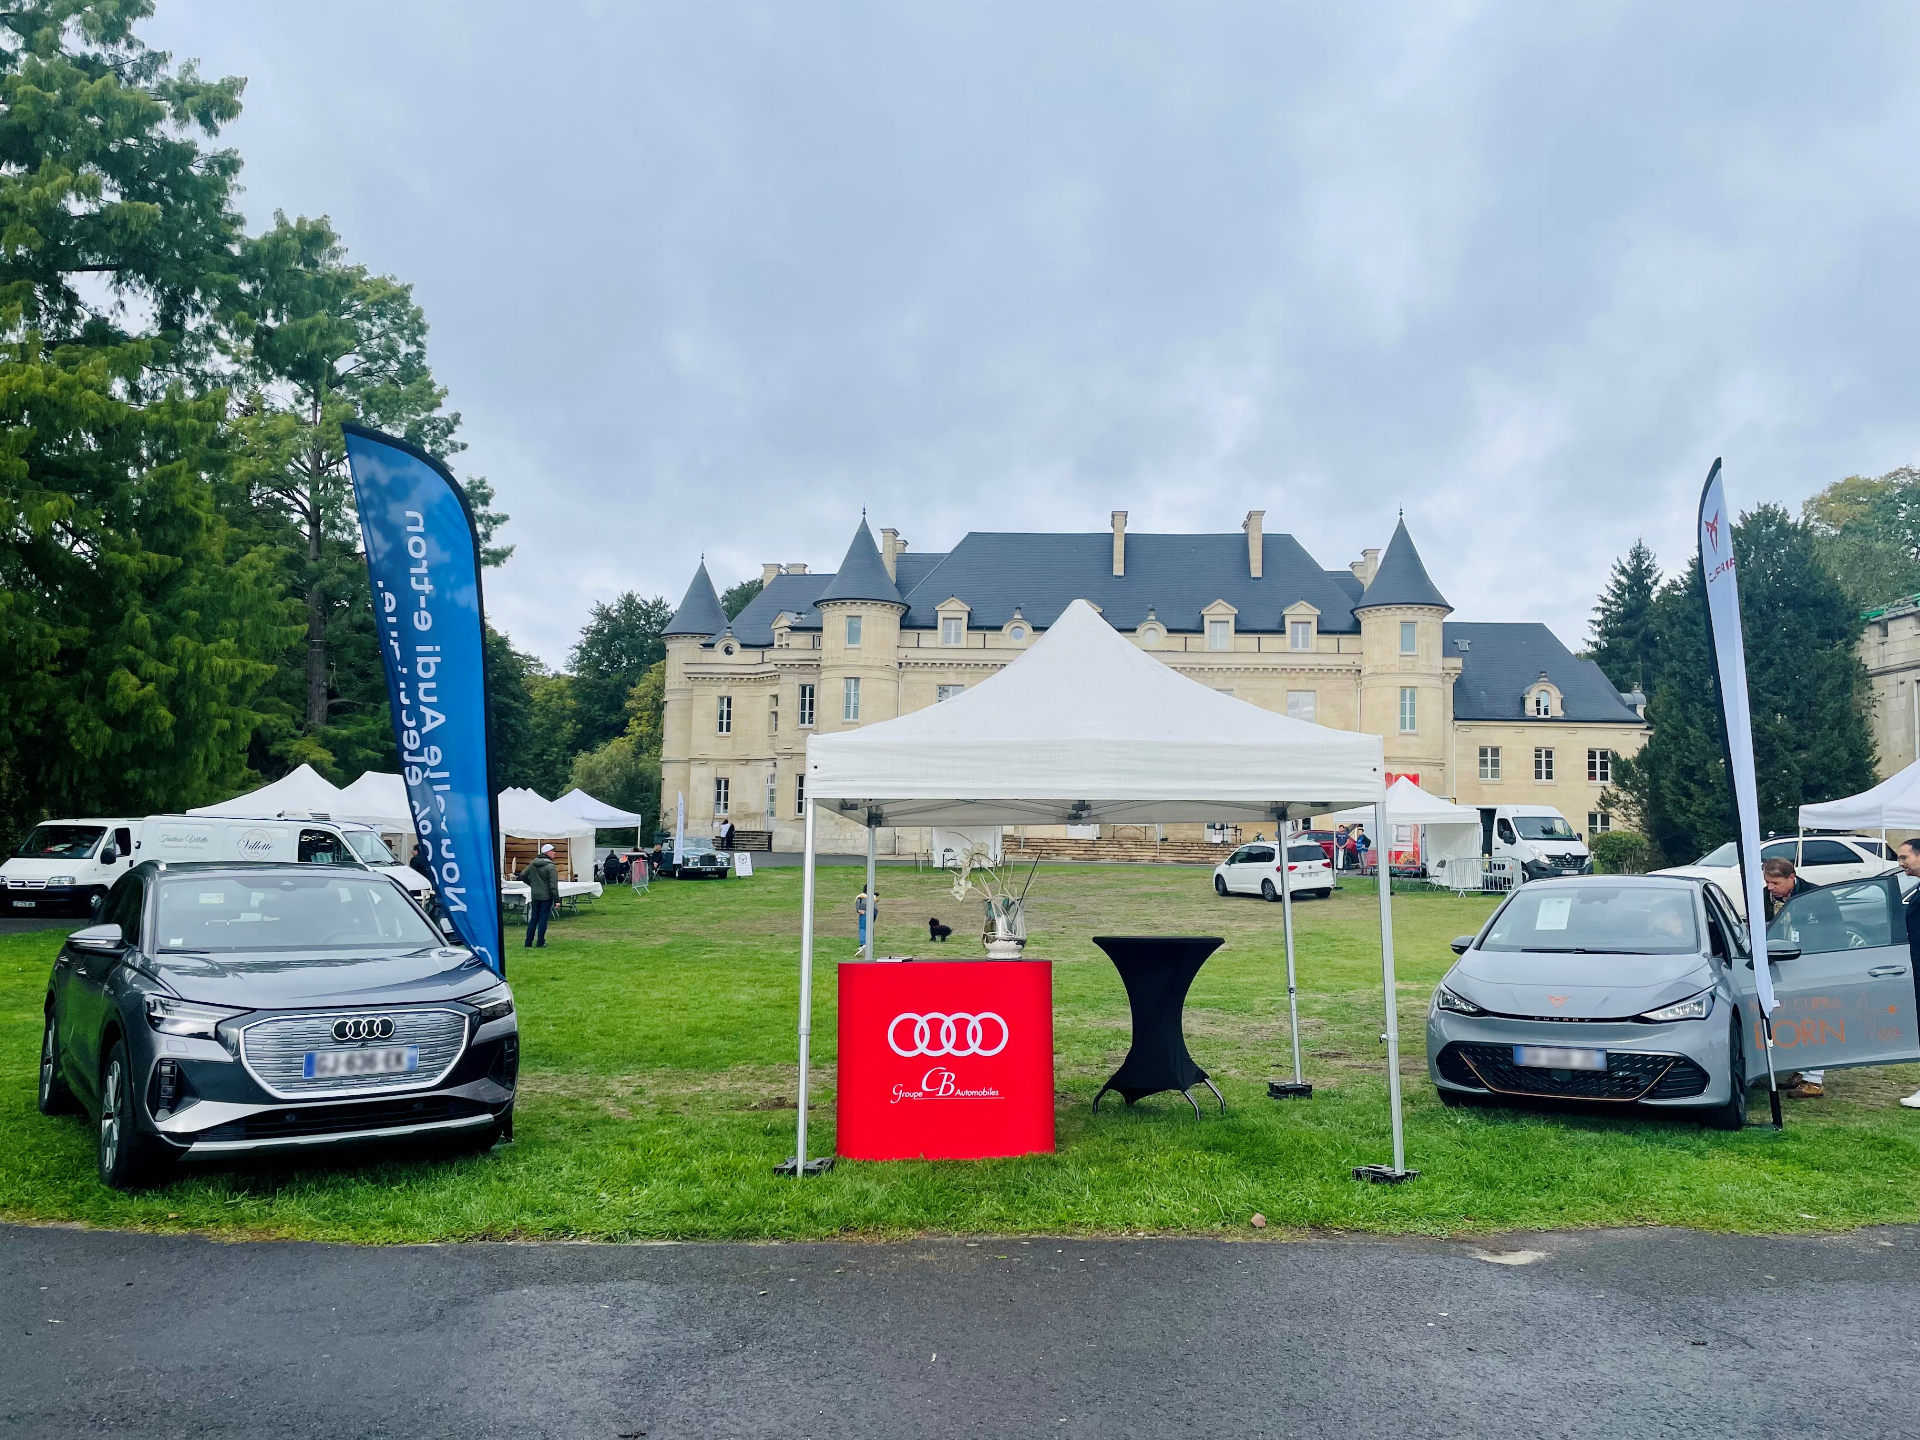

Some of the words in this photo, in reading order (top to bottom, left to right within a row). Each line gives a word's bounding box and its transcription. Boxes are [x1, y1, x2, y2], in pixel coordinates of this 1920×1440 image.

[237, 838, 274, 851] Villette
[890, 1083, 923, 1104] Groupe
[921, 1067, 956, 1096] CB
[955, 1087, 999, 1097] Automobiles
